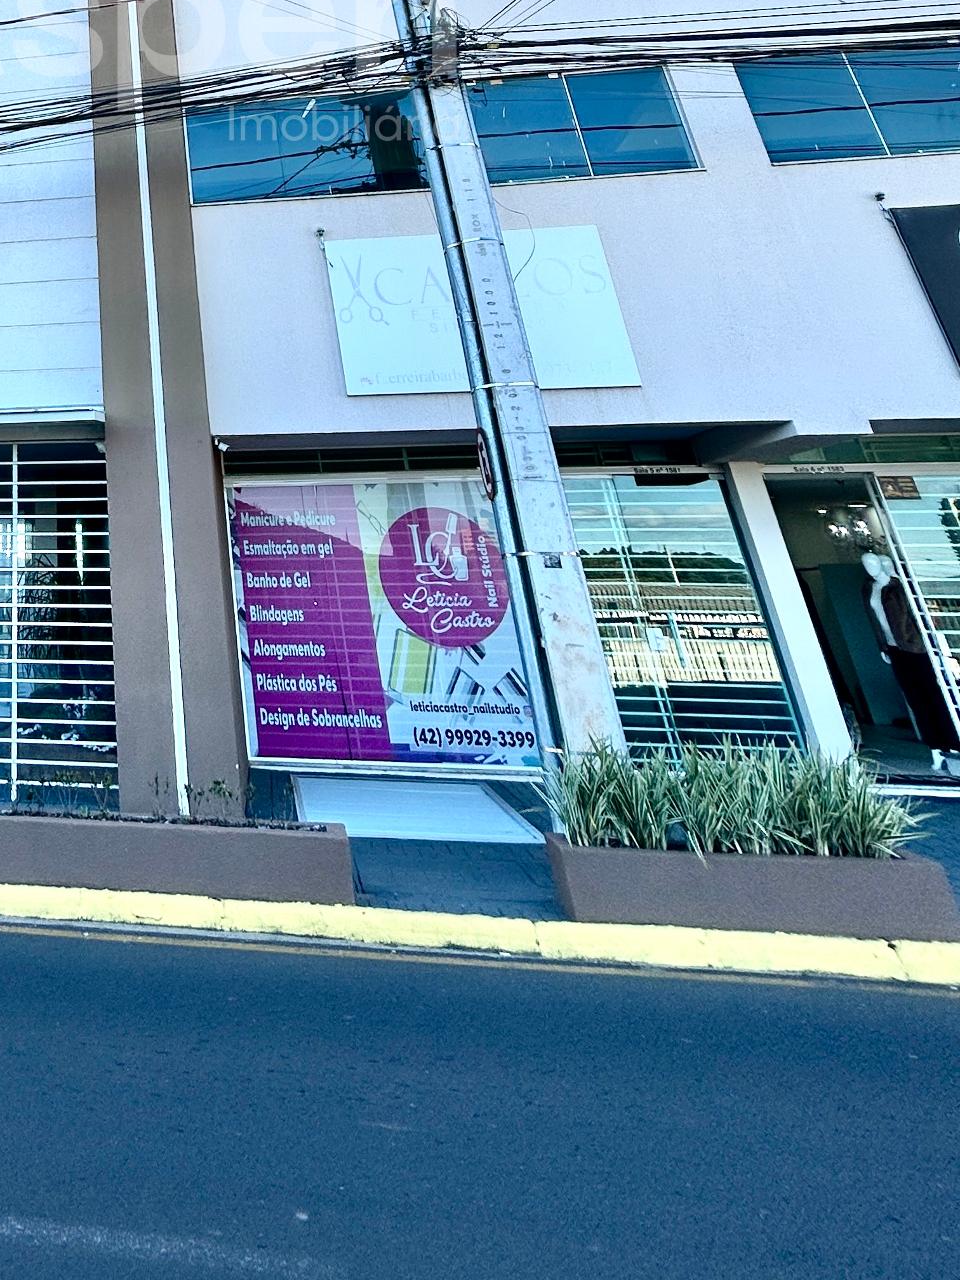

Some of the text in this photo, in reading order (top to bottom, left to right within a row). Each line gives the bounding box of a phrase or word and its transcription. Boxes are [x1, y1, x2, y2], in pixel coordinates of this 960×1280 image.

[374, 254, 606, 306] CAOS
[240, 511, 336, 527] Manicure e Pedicure
[243, 538, 334, 559] Esmaltação em gel
[246, 571, 311, 588] Banho de Gel
[476, 535, 499, 608] Nail Stúdio
[402, 586, 472, 613] Leticia
[249, 604, 304, 626] Blindagens
[430, 608, 495, 633] Castro
[254, 638, 326, 661] Alongamentos
[256, 672, 337, 692] Plástica dos Pés
[409, 699, 521, 716] leticiacastro_nailstudio
[259, 707, 383, 731] Design de Sobrancelhas
[413, 726, 535, 748] (42) 99929-3399
